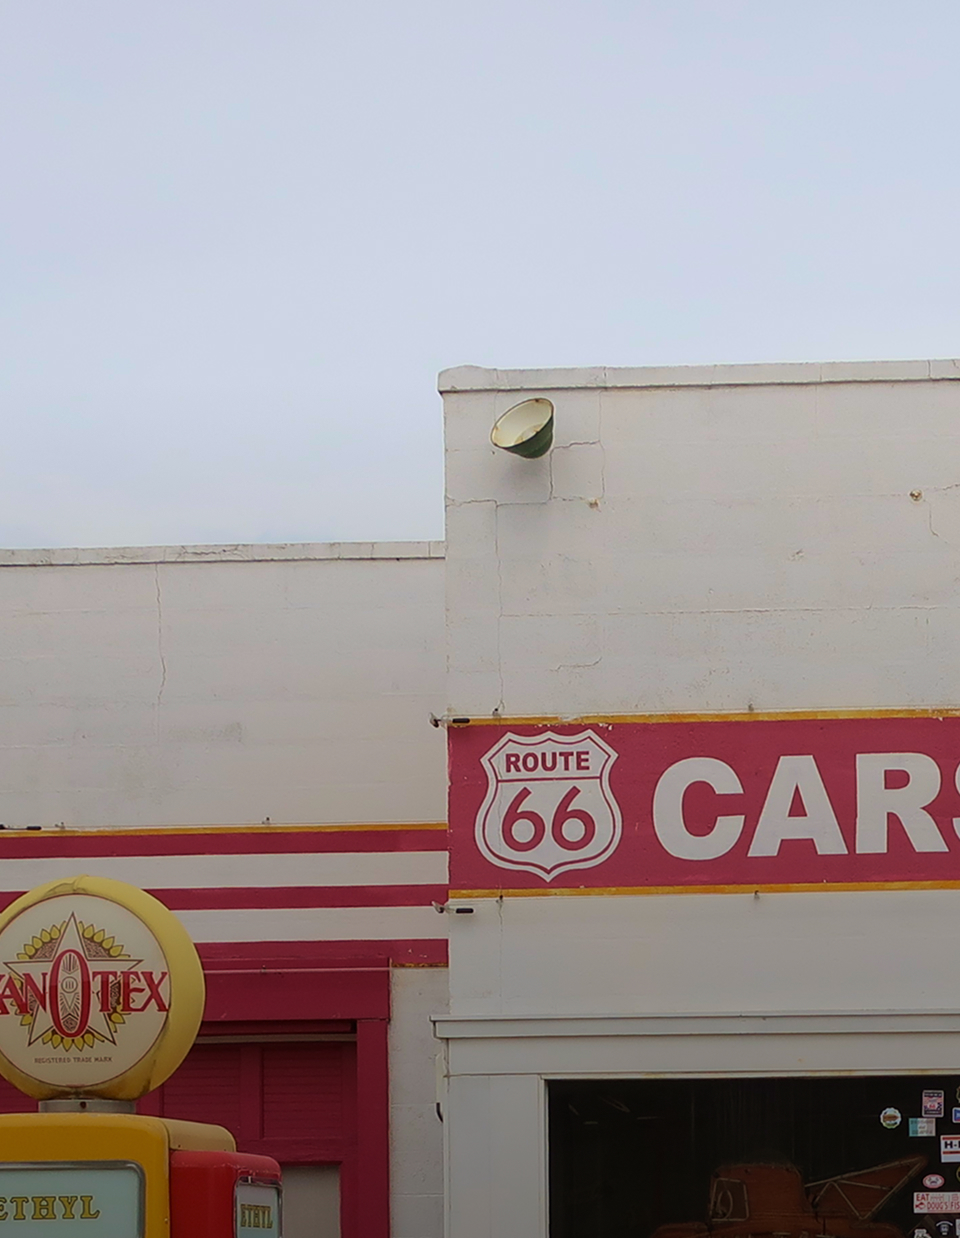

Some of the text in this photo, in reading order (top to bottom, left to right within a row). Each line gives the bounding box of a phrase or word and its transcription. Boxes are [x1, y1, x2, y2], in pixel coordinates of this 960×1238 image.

[504, 750, 591, 774] ROUTE
[500, 785, 597, 852] 66
[916, 1193, 929, 1201] EAT
[240, 1203, 274, 1229] ETHYL
